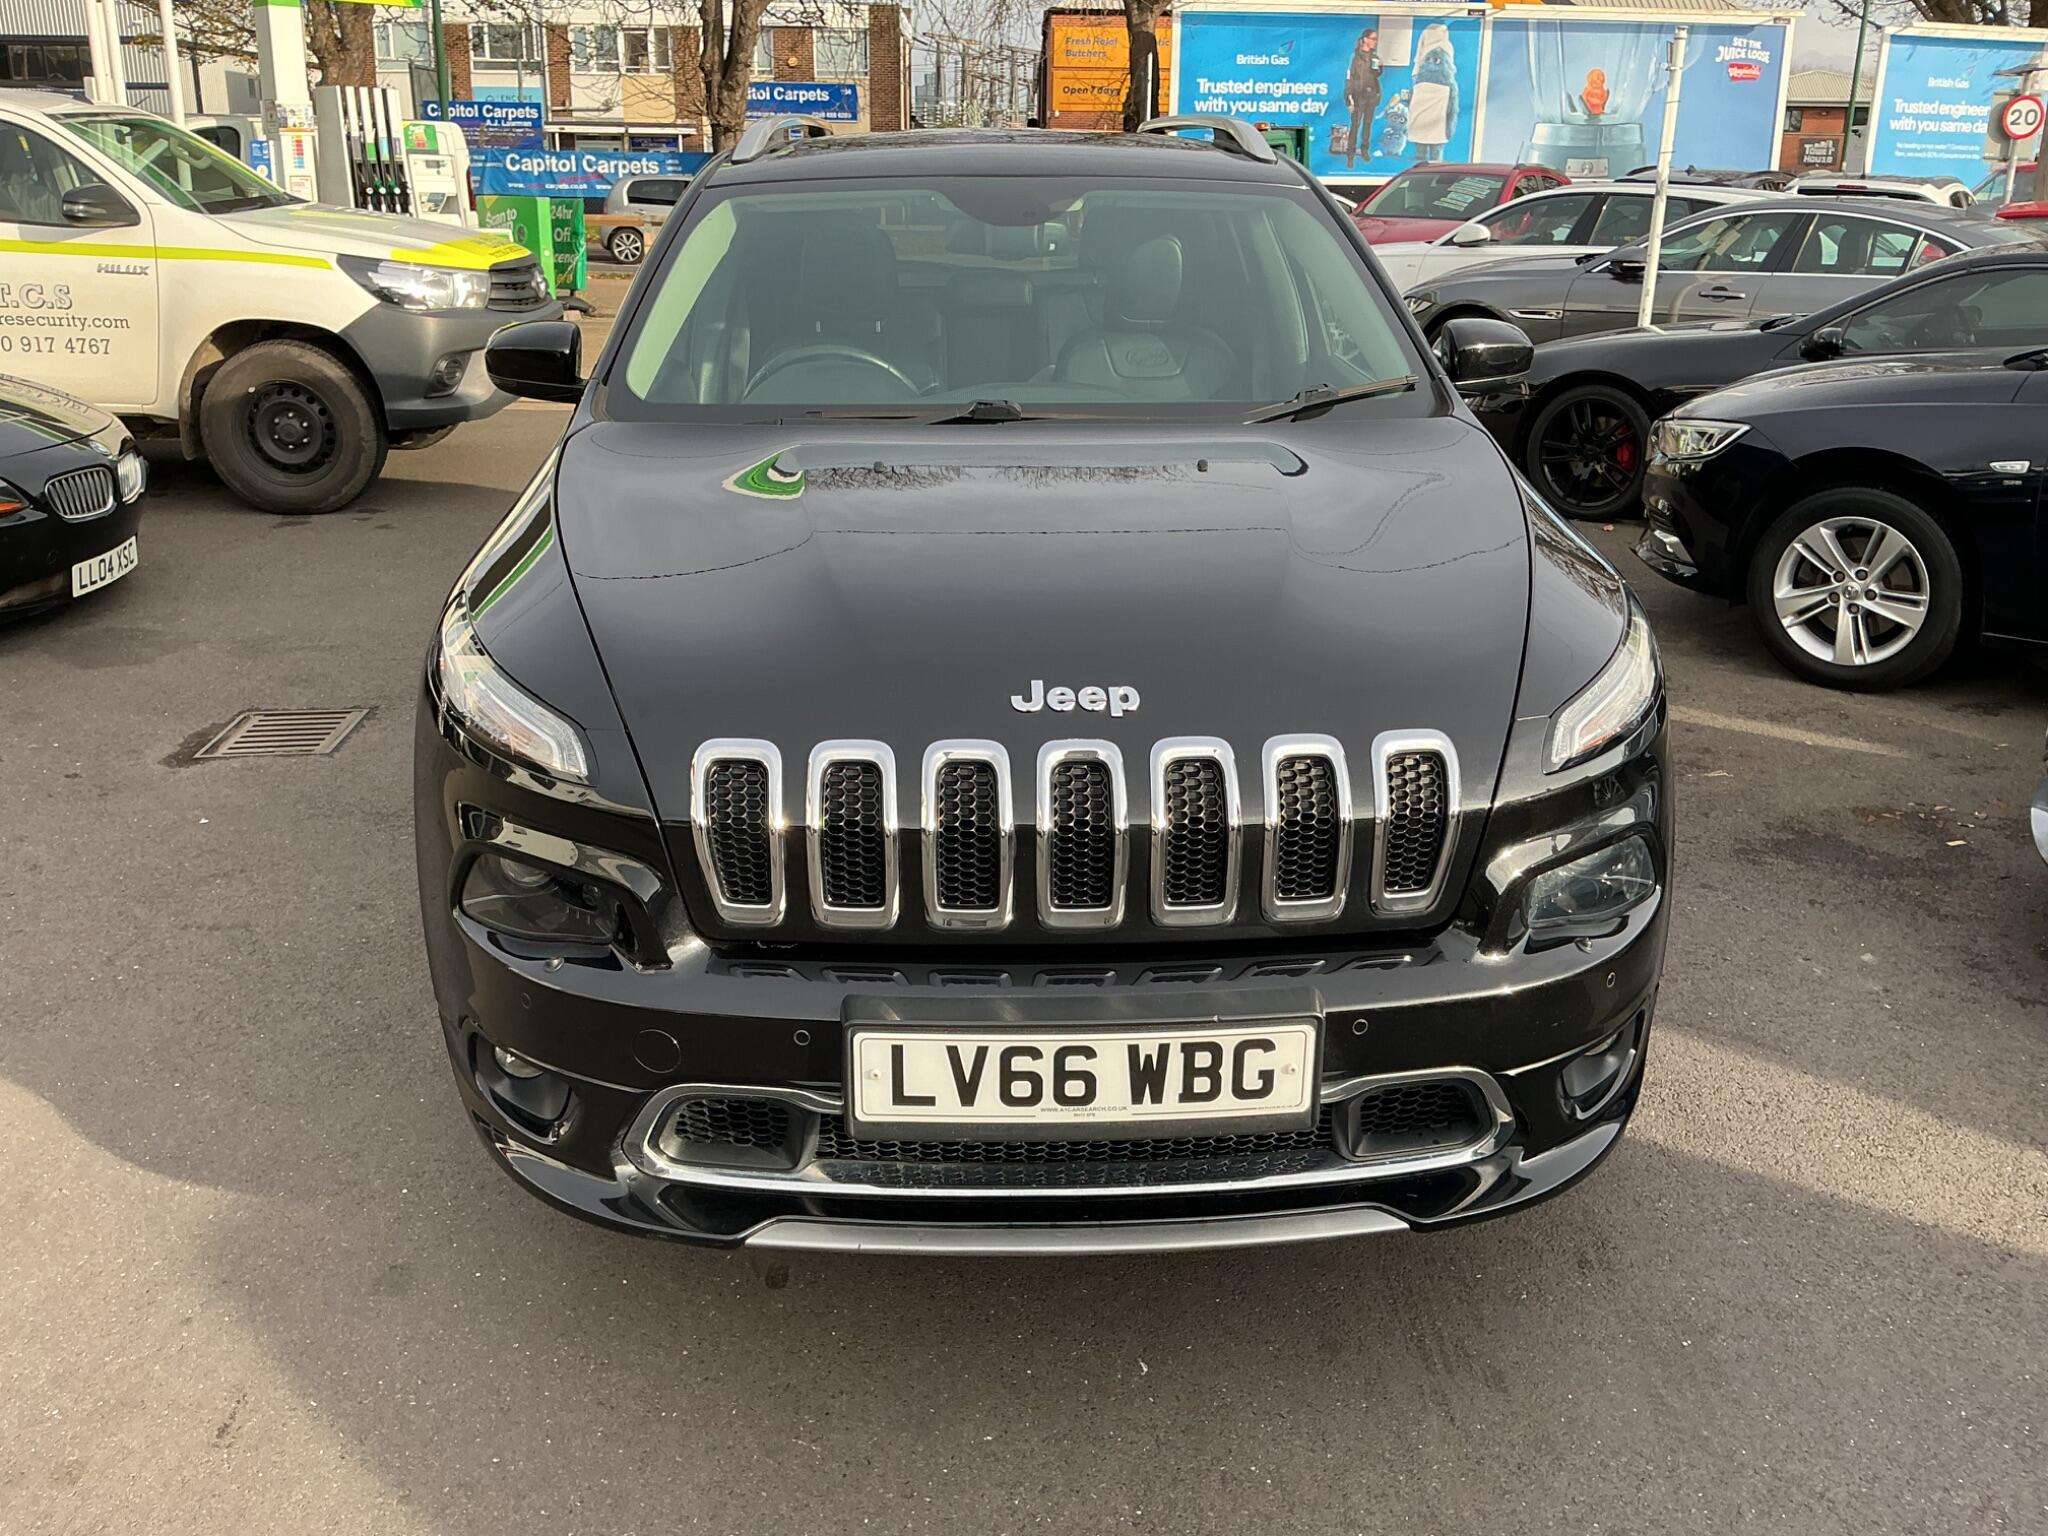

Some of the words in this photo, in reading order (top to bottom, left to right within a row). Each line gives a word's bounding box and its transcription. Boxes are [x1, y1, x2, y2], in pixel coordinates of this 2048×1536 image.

[1065, 36, 1091, 46] Fresh
[1065, 49, 1108, 58] Butchers
[1236, 54, 1269, 65] British
[1271, 54, 1290, 65] Gas
[1715, 45, 1747, 62] JUICE
[1747, 49, 1771, 64] LOOSE
[1062, 86, 1089, 95] Open
[1196, 78, 1254, 95] Trusted
[1255, 78, 1329, 97] engineers
[1927, 77, 1954, 88] British
[1955, 78, 1970, 89] Gas
[746, 86, 771, 101] itol
[773, 86, 830, 104] Carpets
[426, 103, 479, 120] Cpitol
[482, 104, 539, 121] Carpets
[1193, 96, 1228, 113] with
[1228, 100, 1257, 116] you
[1258, 101, 1299, 113] same
[1300, 98, 1329, 116] day
[1894, 98, 1939, 115] Trusted
[1939, 98, 1990, 119] engineer
[1889, 115, 1916, 131] with
[1917, 120, 1940, 135] you
[1940, 121, 1972, 133] same
[1973, 119, 1988, 134] da
[2009, 108, 2039, 126] 20
[506, 153, 577, 176] Capitol
[582, 154, 660, 179] Carpets
[551, 205, 573, 220] 24hr
[97, 263, 150, 276] HILUX
[20, 336, 55, 353] 917
[65, 336, 111, 355] 4767
[79, 554, 114, 590] LL04
[116, 542, 135, 573] XSC
[1010, 679, 1141, 718] Jeep
[890, 1043, 1099, 1108] LV66
[1127, 1037, 1277, 1106] WBG
